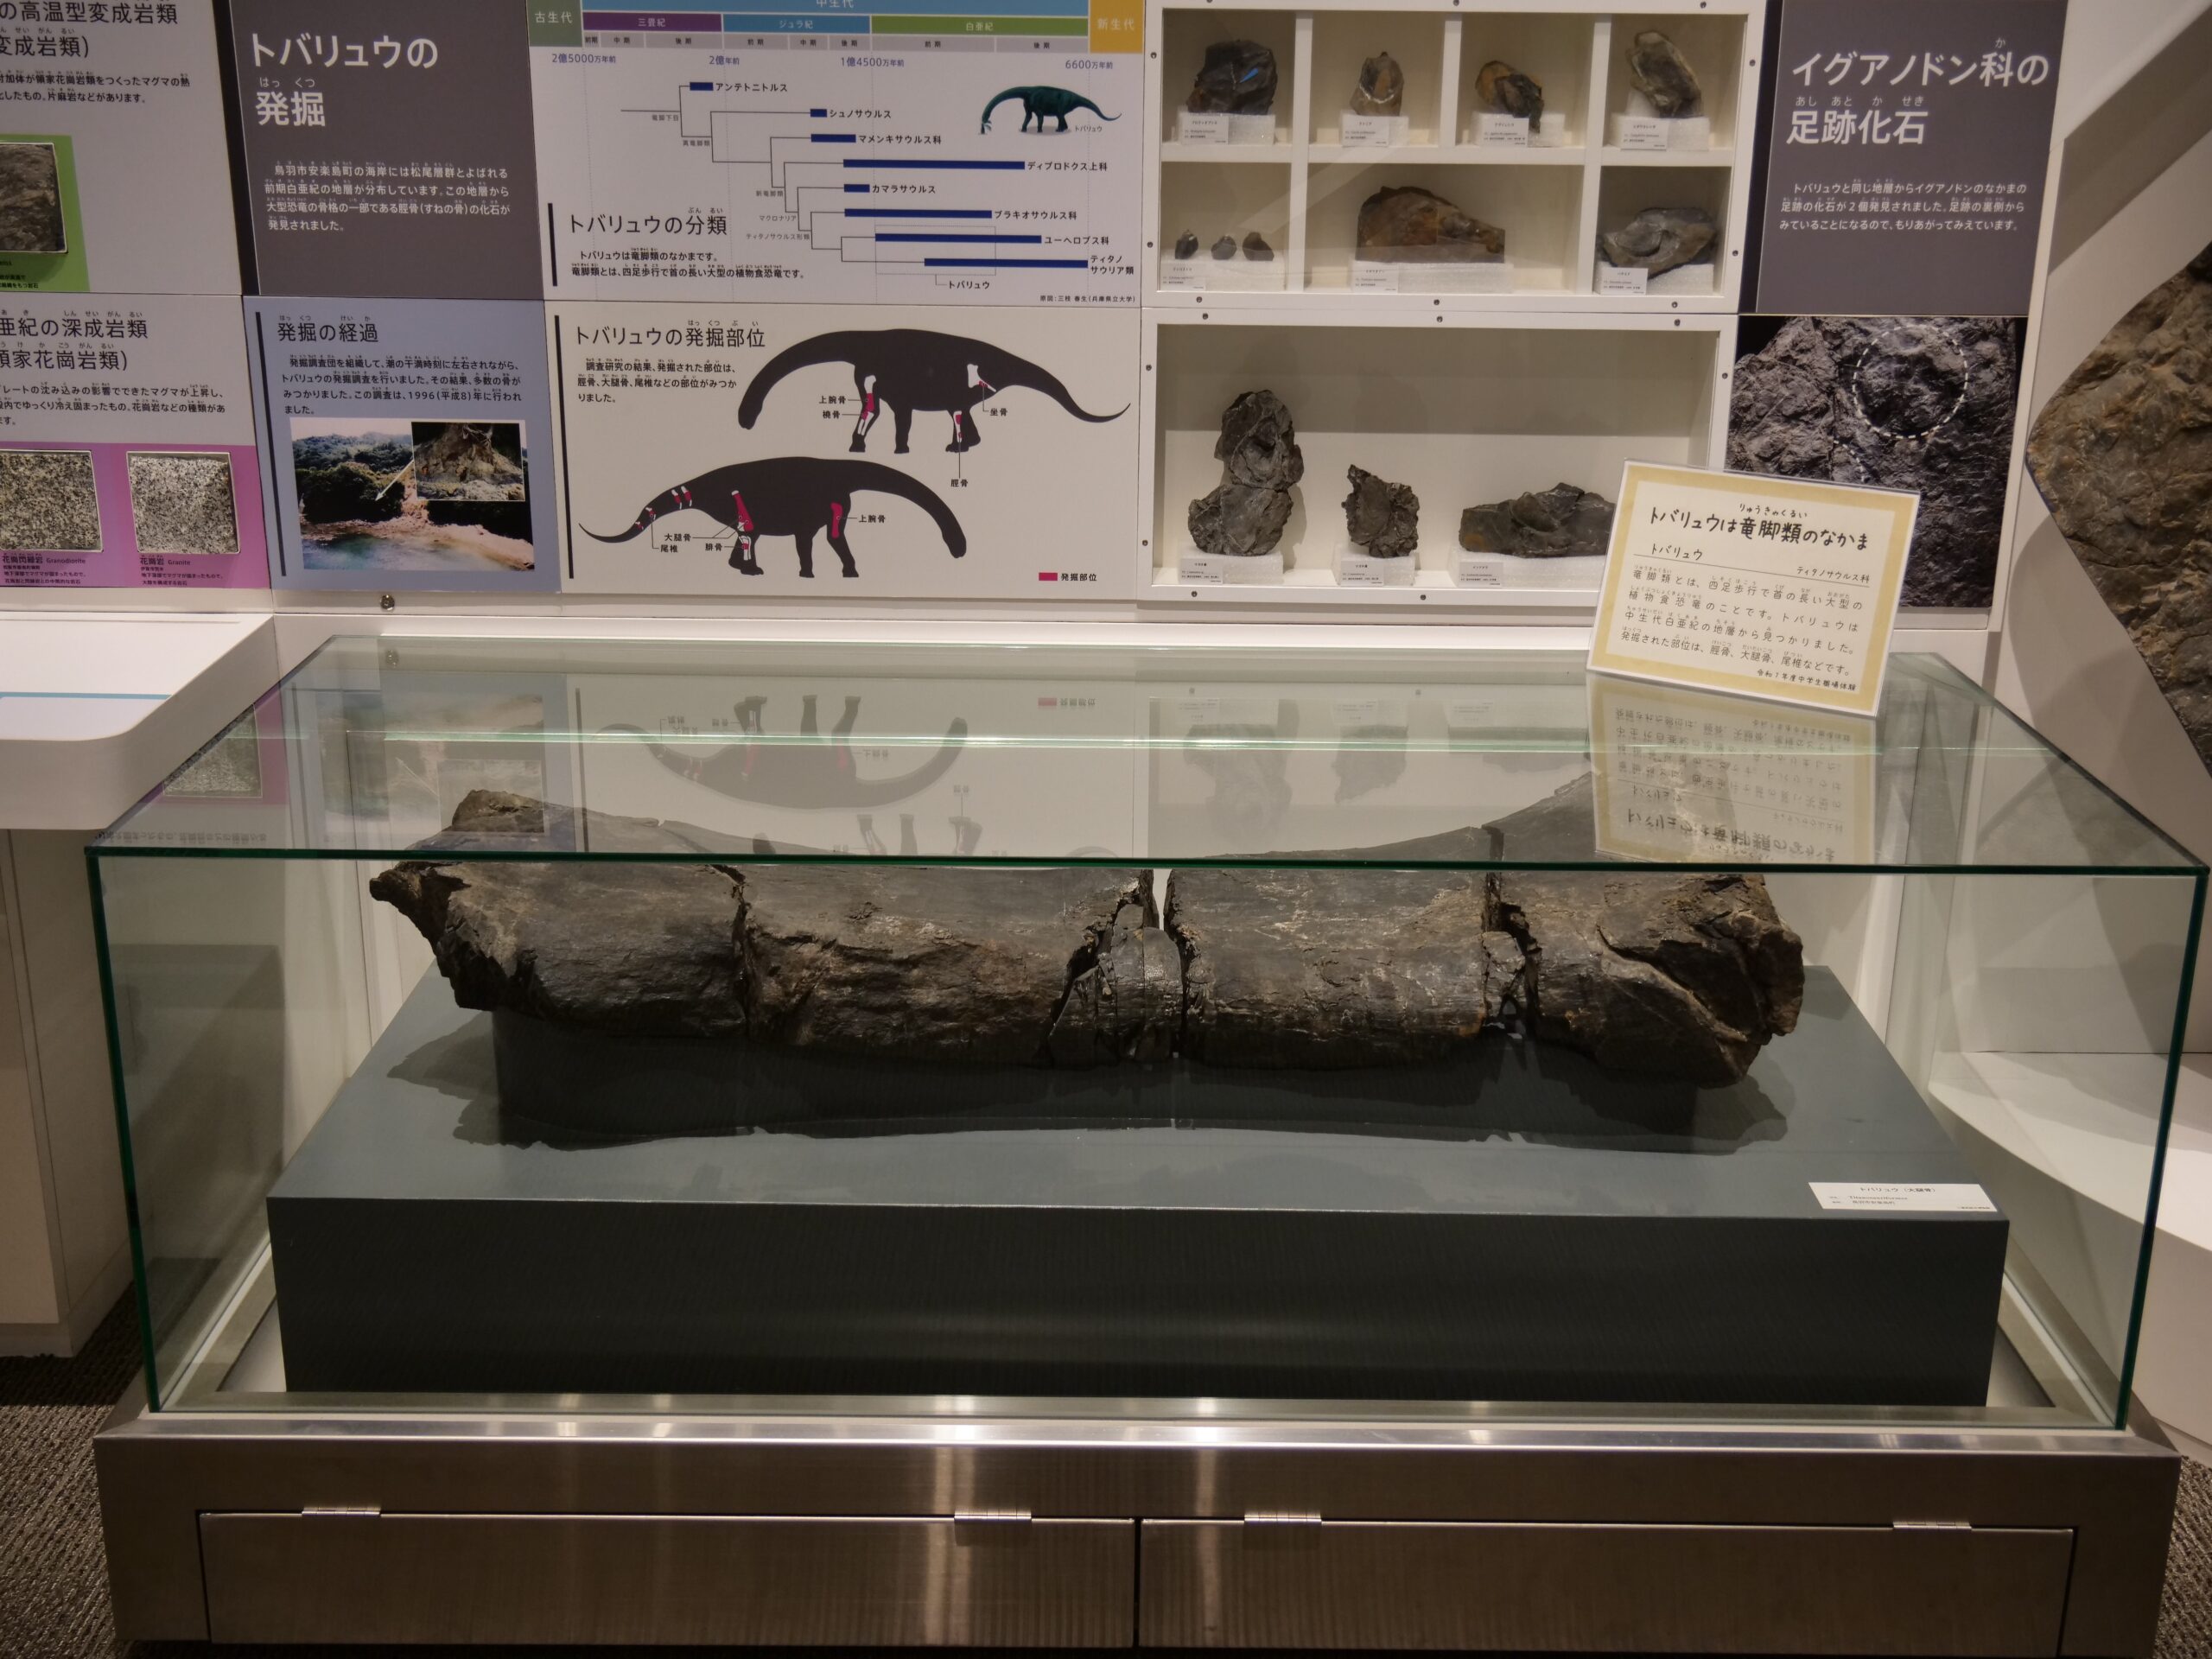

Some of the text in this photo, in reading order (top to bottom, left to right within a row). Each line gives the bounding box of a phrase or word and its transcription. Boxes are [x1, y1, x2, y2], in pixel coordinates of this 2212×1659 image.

[0, 1, 178, 24] の高温型変成岩類
[535, 11, 573, 24] 古生代
[638, 18, 666, 28] 三畳紀
[779, 20, 814, 29] ジュラ紀
[966, 22, 994, 31] 白亜紀
[1097, 18, 1135, 31] 新生代
[1995, 37, 2006, 48] か
[252, 33, 438, 68] トバリュウの
[551, 54, 616, 64] 2億5000万年前
[709, 55, 740, 66] 2億年前
[841, 57, 905, 67] 1億4500万年前
[1065, 60, 1113, 70] 6600万年前
[1792, 50, 2050, 86] イグアノドン科の
[260, 77, 315, 87] はっ くつ
[715, 83, 787, 92] アンテトニトルス
[1796, 96, 1924, 107] あし あと か せき
[256, 91, 326, 127] 発掘
[829, 109, 892, 119] シュノサウルス
[1786, 110, 1929, 145] 足跡化石
[859, 135, 942, 145] マメンキサウルス科
[264, 183, 509, 197] 前期白亜紀の地層が分布しています。この地層から
[872, 184, 936, 194] カマラサウルス
[1794, 183, 2026, 194] トバリュウと同じ地層からイグアノドンのなかまの
[995, 210, 1077, 220] ブラキオサウルス科
[268, 220, 344, 232] 発見されました。
[571, 214, 727, 235] トバリュウの分類
[1779, 219, 2018, 231] みていることになるので、もりあがってみえています。
[581, 251, 717, 262] トバリュウは竜脚類のなかまです。
[1090, 255, 1122, 264] ティタノ
[572, 268, 804, 279] 竜脚類とは、四足歩行で首の長い大型の植物食恐竜です。
[1090, 266, 1135, 275] サウリア類
[949, 280, 990, 289] トバリュウ
[0, 318, 148, 339] 亜紀の深成岩類
[277, 322, 378, 343] 発掘の経過
[577, 327, 766, 347] トバリュウの発掘部位
[586, 361, 736, 373] 調査研究の結果、発掘された部位は、
[282, 374, 521, 386] トバリュウの発掘調査を行いました。その結果、多数の骨が
[577, 378, 737, 389] 脛骨、大腿骨、尾椎などの部位がみつか
[0, 385, 224, 397] レートの沈み込みの影響でできたマグマが上昇し、
[578, 393, 616, 404] りました。
[284, 405, 315, 415] ました。
[1739, 503, 1808, 518] りゅうきゃくるい
[1650, 506, 1868, 550] トバリュウは竜脚類のなかま
[1651, 543, 1702, 561] トバリュウ
[1060, 573, 1097, 582] 発掘部位
[1796, 566, 1870, 583] ティタノサウルス科
[1633, 569, 1862, 610] 竜脚類とは、四足歩行で首の長い大型の
[1625, 611, 1853, 655] 中生代白亜紀の地層から見つかりました。
[1621, 632, 1849, 677] 発掘された部位は、脛骨、大腿骨、尾椎などです。
